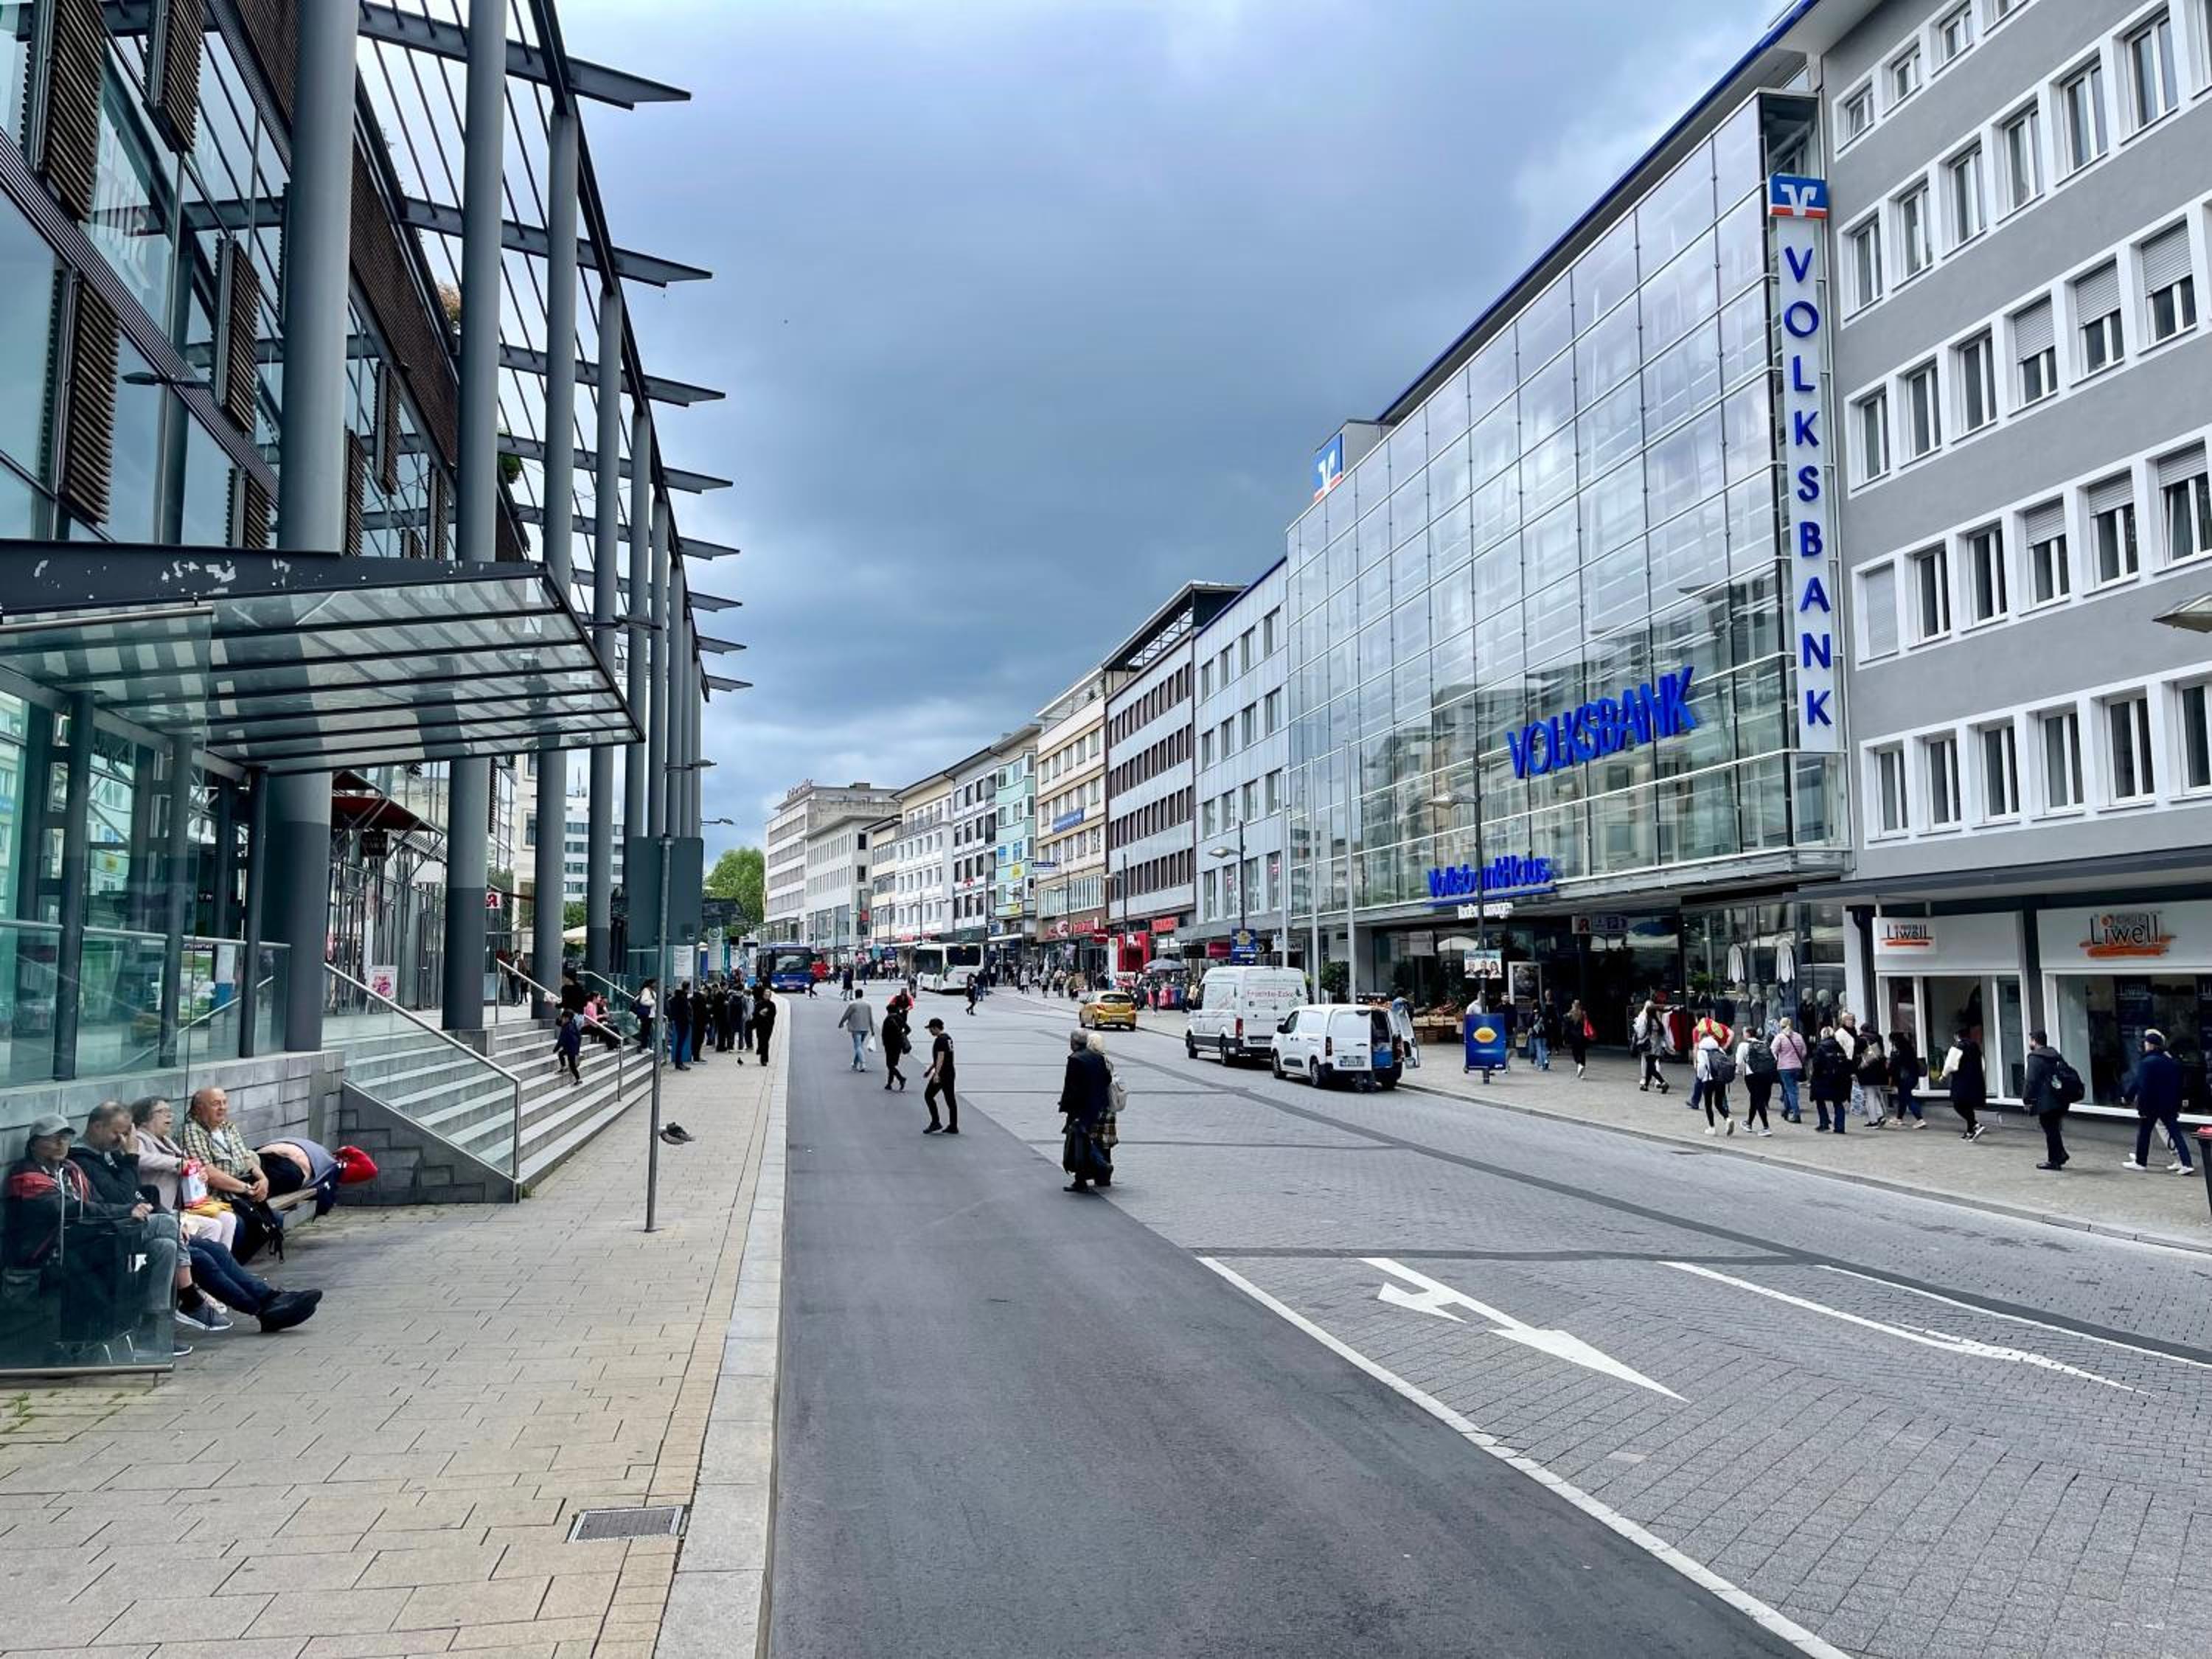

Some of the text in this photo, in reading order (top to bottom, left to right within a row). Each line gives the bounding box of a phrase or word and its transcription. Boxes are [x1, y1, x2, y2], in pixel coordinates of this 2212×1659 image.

[1784, 246, 1832, 726] VOLKSBANK
[1506, 665, 1697, 779] VOLKSBANK
[1887, 924, 1927, 939] Liwell
[2090, 914, 2159, 945] Liwell
